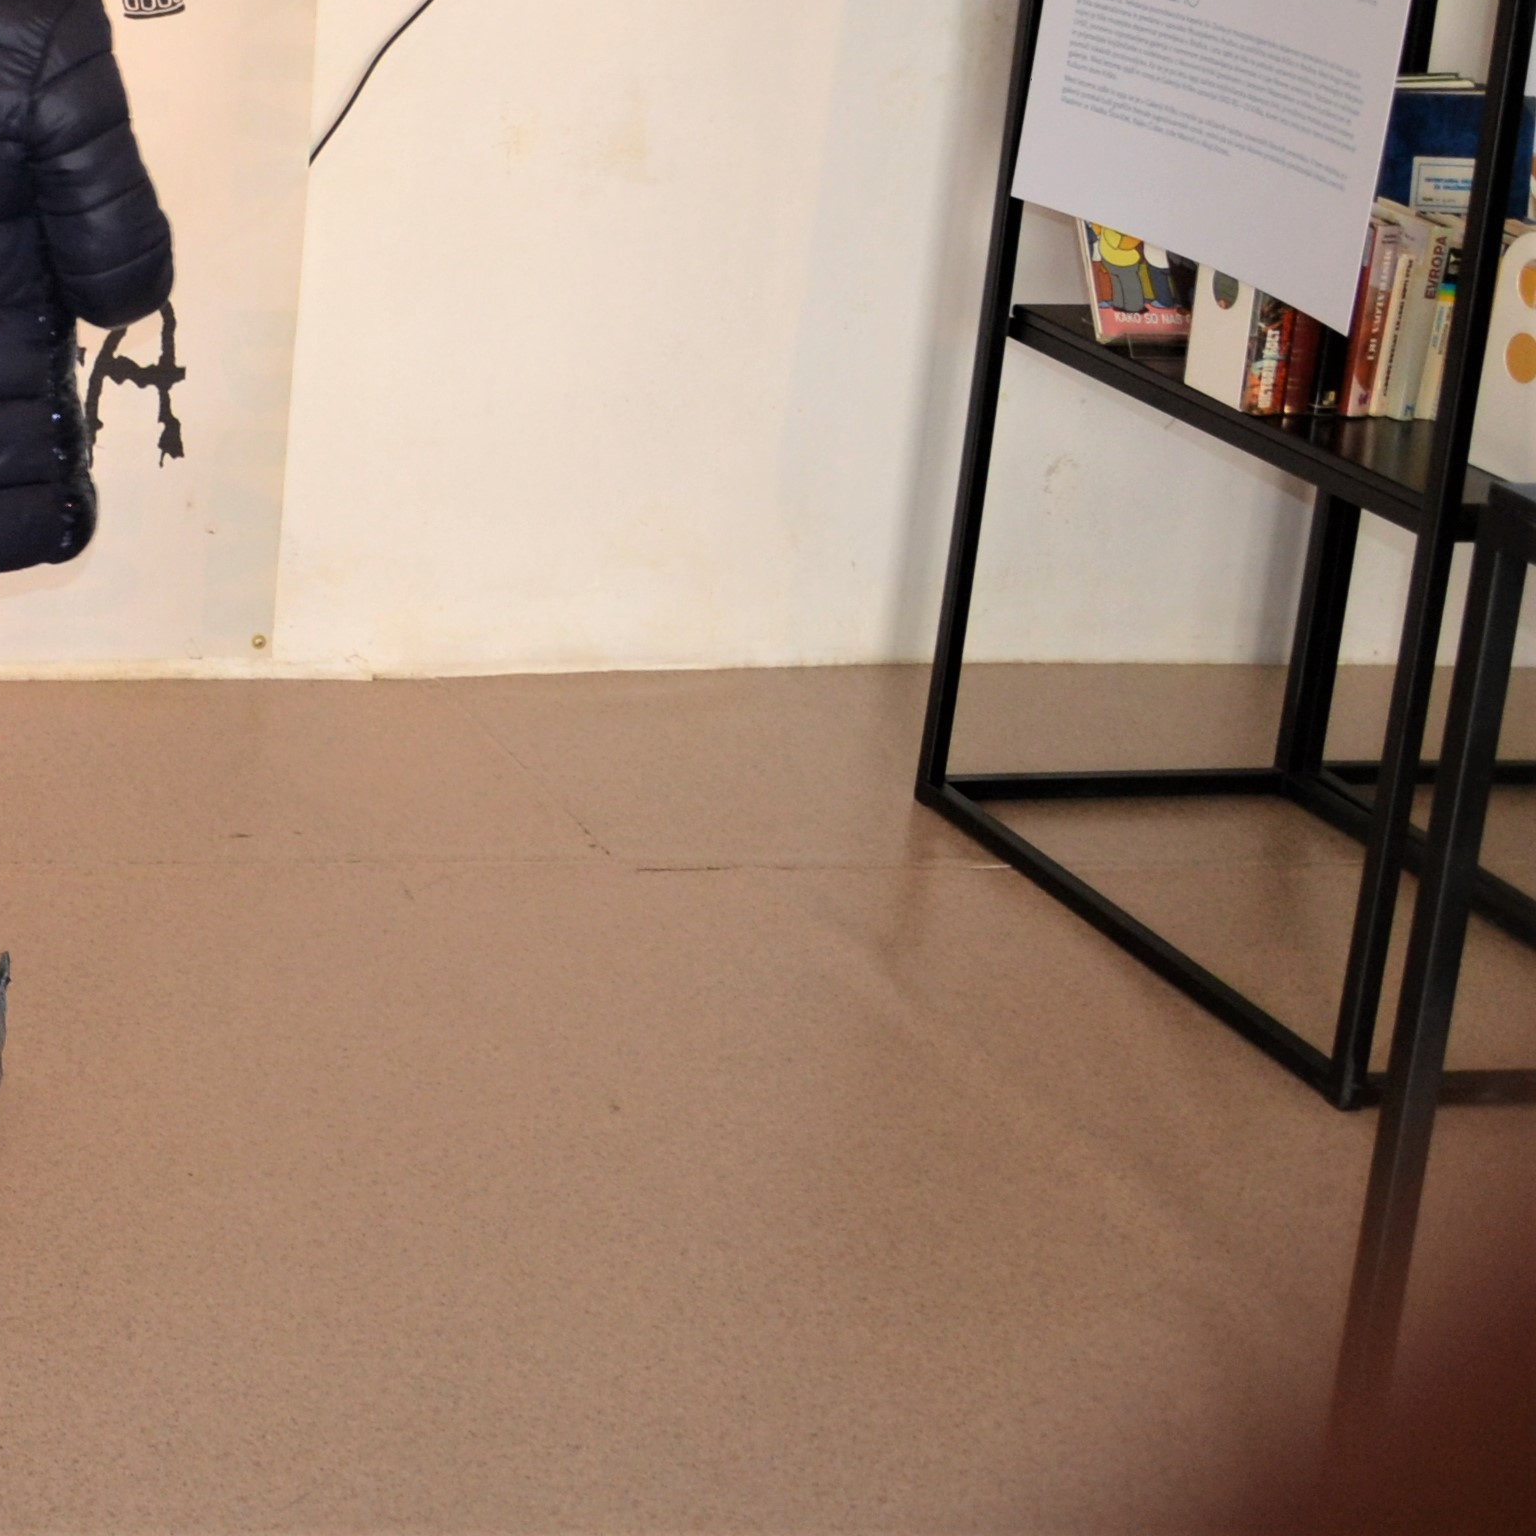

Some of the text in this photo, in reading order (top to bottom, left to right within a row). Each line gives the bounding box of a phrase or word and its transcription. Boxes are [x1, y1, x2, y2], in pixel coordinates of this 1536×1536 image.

[1424, 236, 1447, 300] EVROPA
[1114, 311, 1142, 324] KAKO
[1144, 313, 1159, 324] SO
[1161, 313, 1183, 325] NAS
